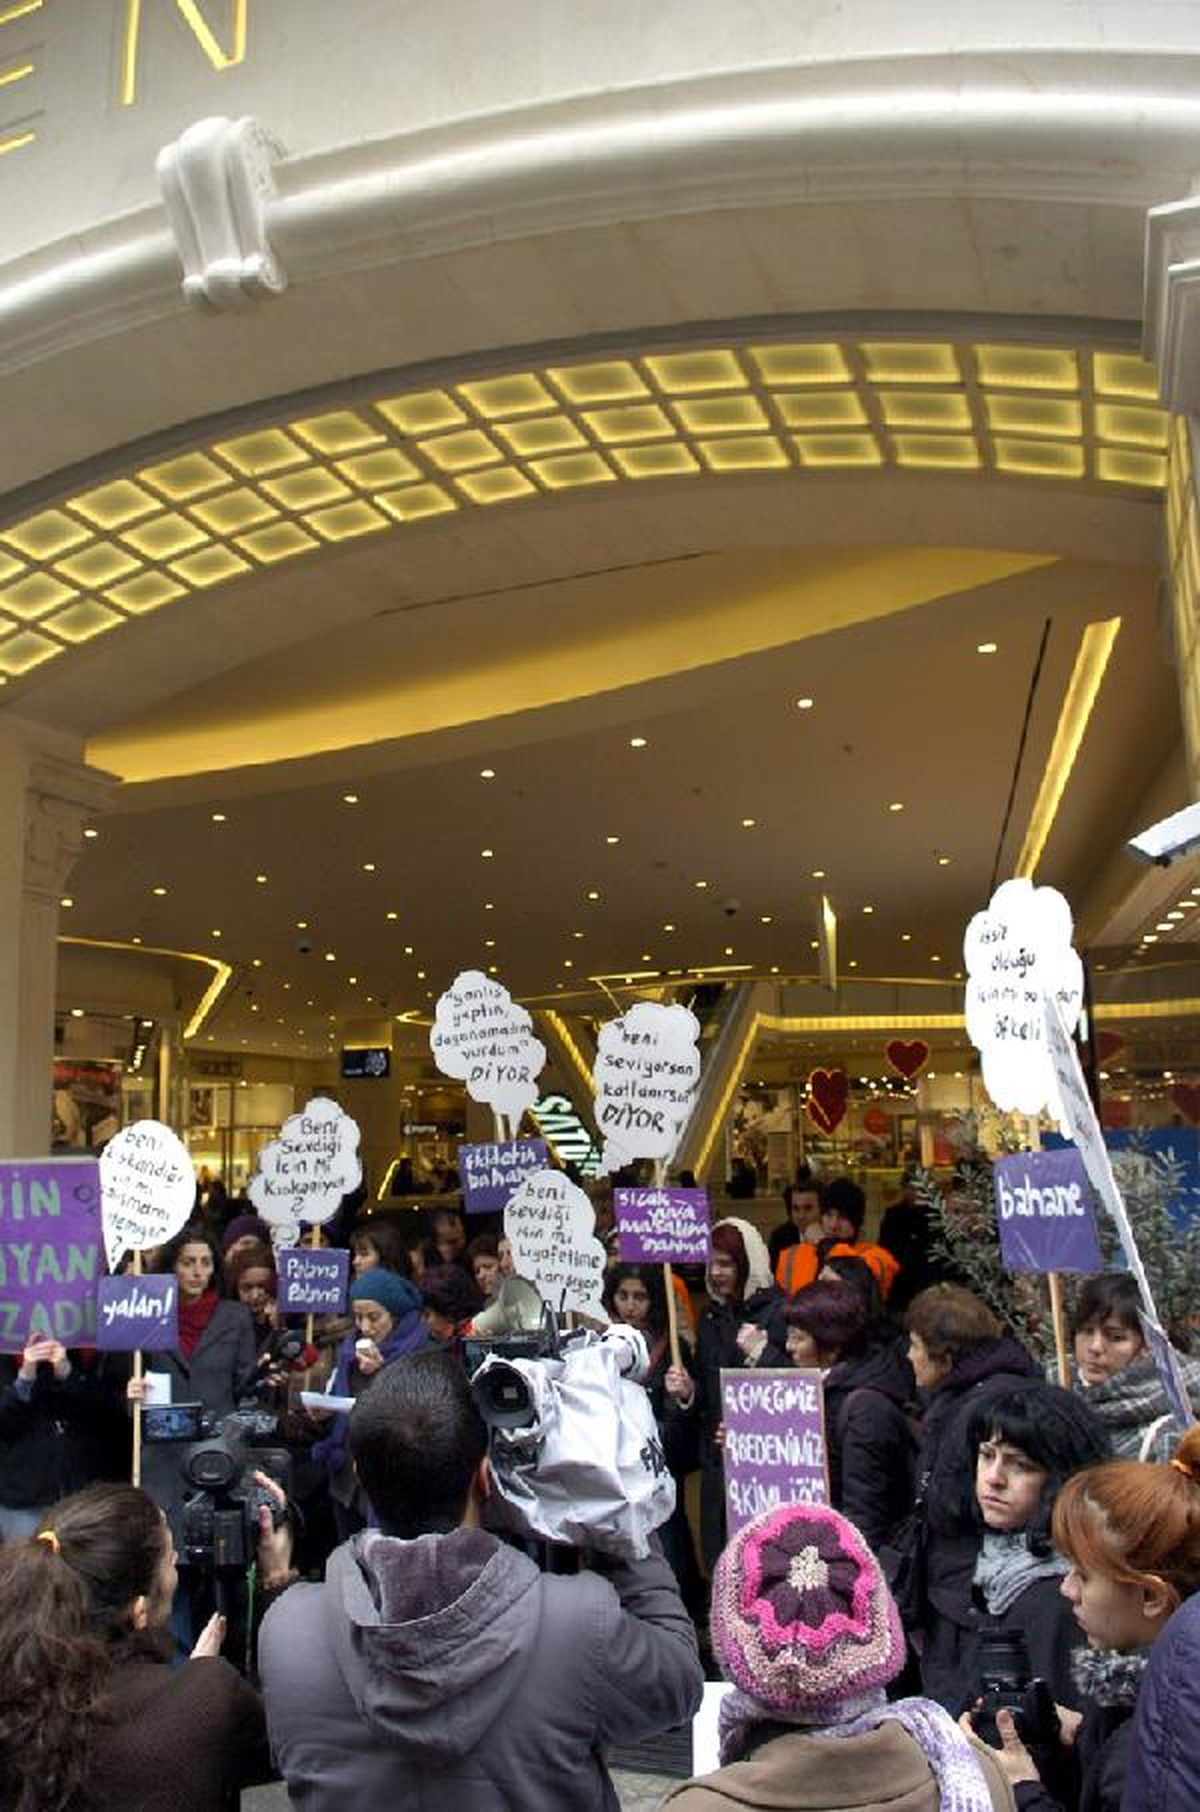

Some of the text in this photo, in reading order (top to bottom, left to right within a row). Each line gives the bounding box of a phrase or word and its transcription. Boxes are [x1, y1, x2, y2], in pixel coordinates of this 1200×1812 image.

[604, 1054, 694, 1079] seviyorsan
[301, 1117, 339, 1135] Beni
[601, 1102, 666, 1133] DİYOR
[281, 1136, 342, 1159] Sevdiği
[0, 1171, 62, 1221] İN
[525, 1182, 568, 1201] beni
[997, 1173, 1086, 1219] bahane
[507, 1204, 570, 1230] sevdiği
[103, 1286, 174, 1326] yalan!
